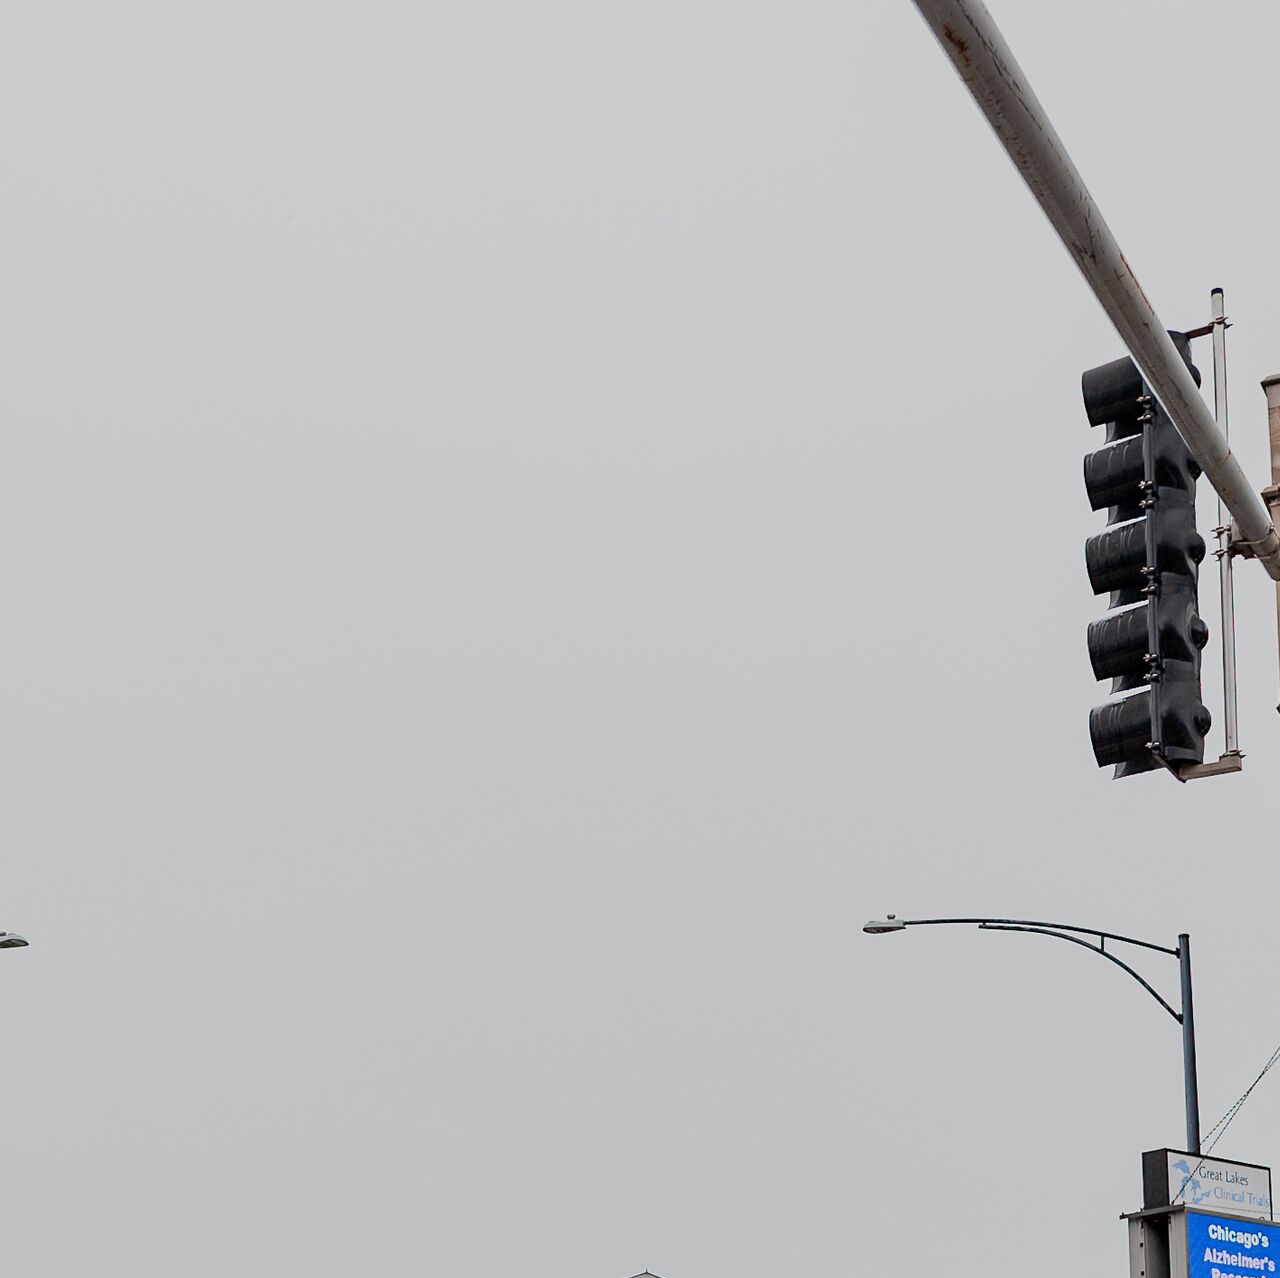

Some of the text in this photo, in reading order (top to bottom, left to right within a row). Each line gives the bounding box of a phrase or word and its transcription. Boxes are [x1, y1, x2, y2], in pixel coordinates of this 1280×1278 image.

[1199, 1166, 1249, 1186] Great Lakes
[1214, 1187, 1269, 1208] Clinical Trials
[1208, 1224, 1269, 1249] Chicago's
[1204, 1247, 1276, 1272] Alzheimer's
